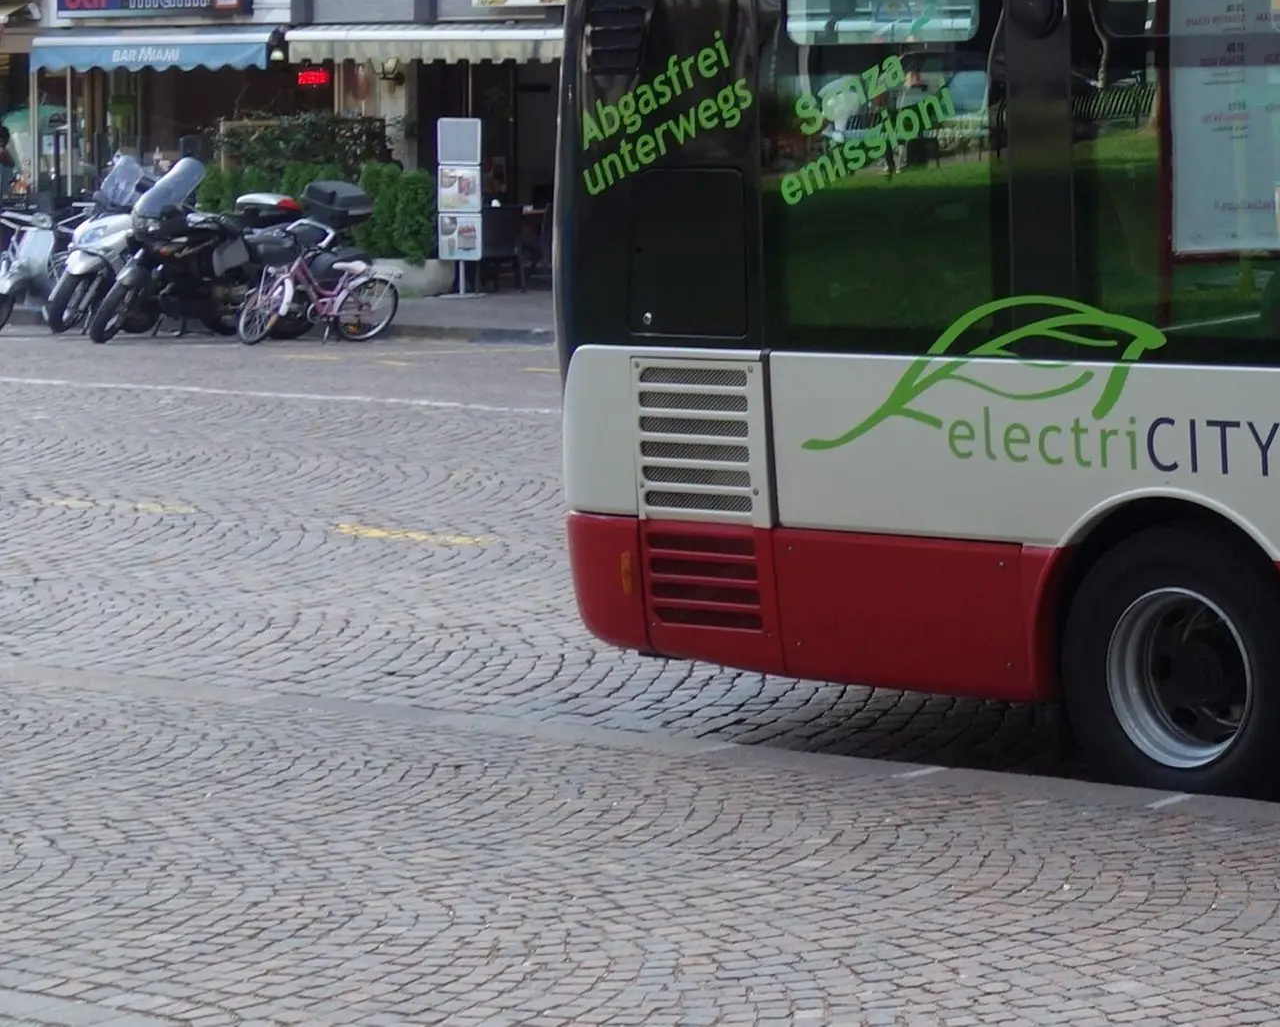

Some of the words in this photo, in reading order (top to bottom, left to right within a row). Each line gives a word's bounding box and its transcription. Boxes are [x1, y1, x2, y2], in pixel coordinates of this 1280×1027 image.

[112, 48, 137, 62] BAR
[137, 46, 180, 62] MIAMI
[580, 30, 731, 151] Abgasfrei
[795, 53, 904, 136] Senza
[582, 77, 753, 196] unterwegs
[780, 76, 957, 206] emissioni
[947, 406, 1280, 477] electriCITY
